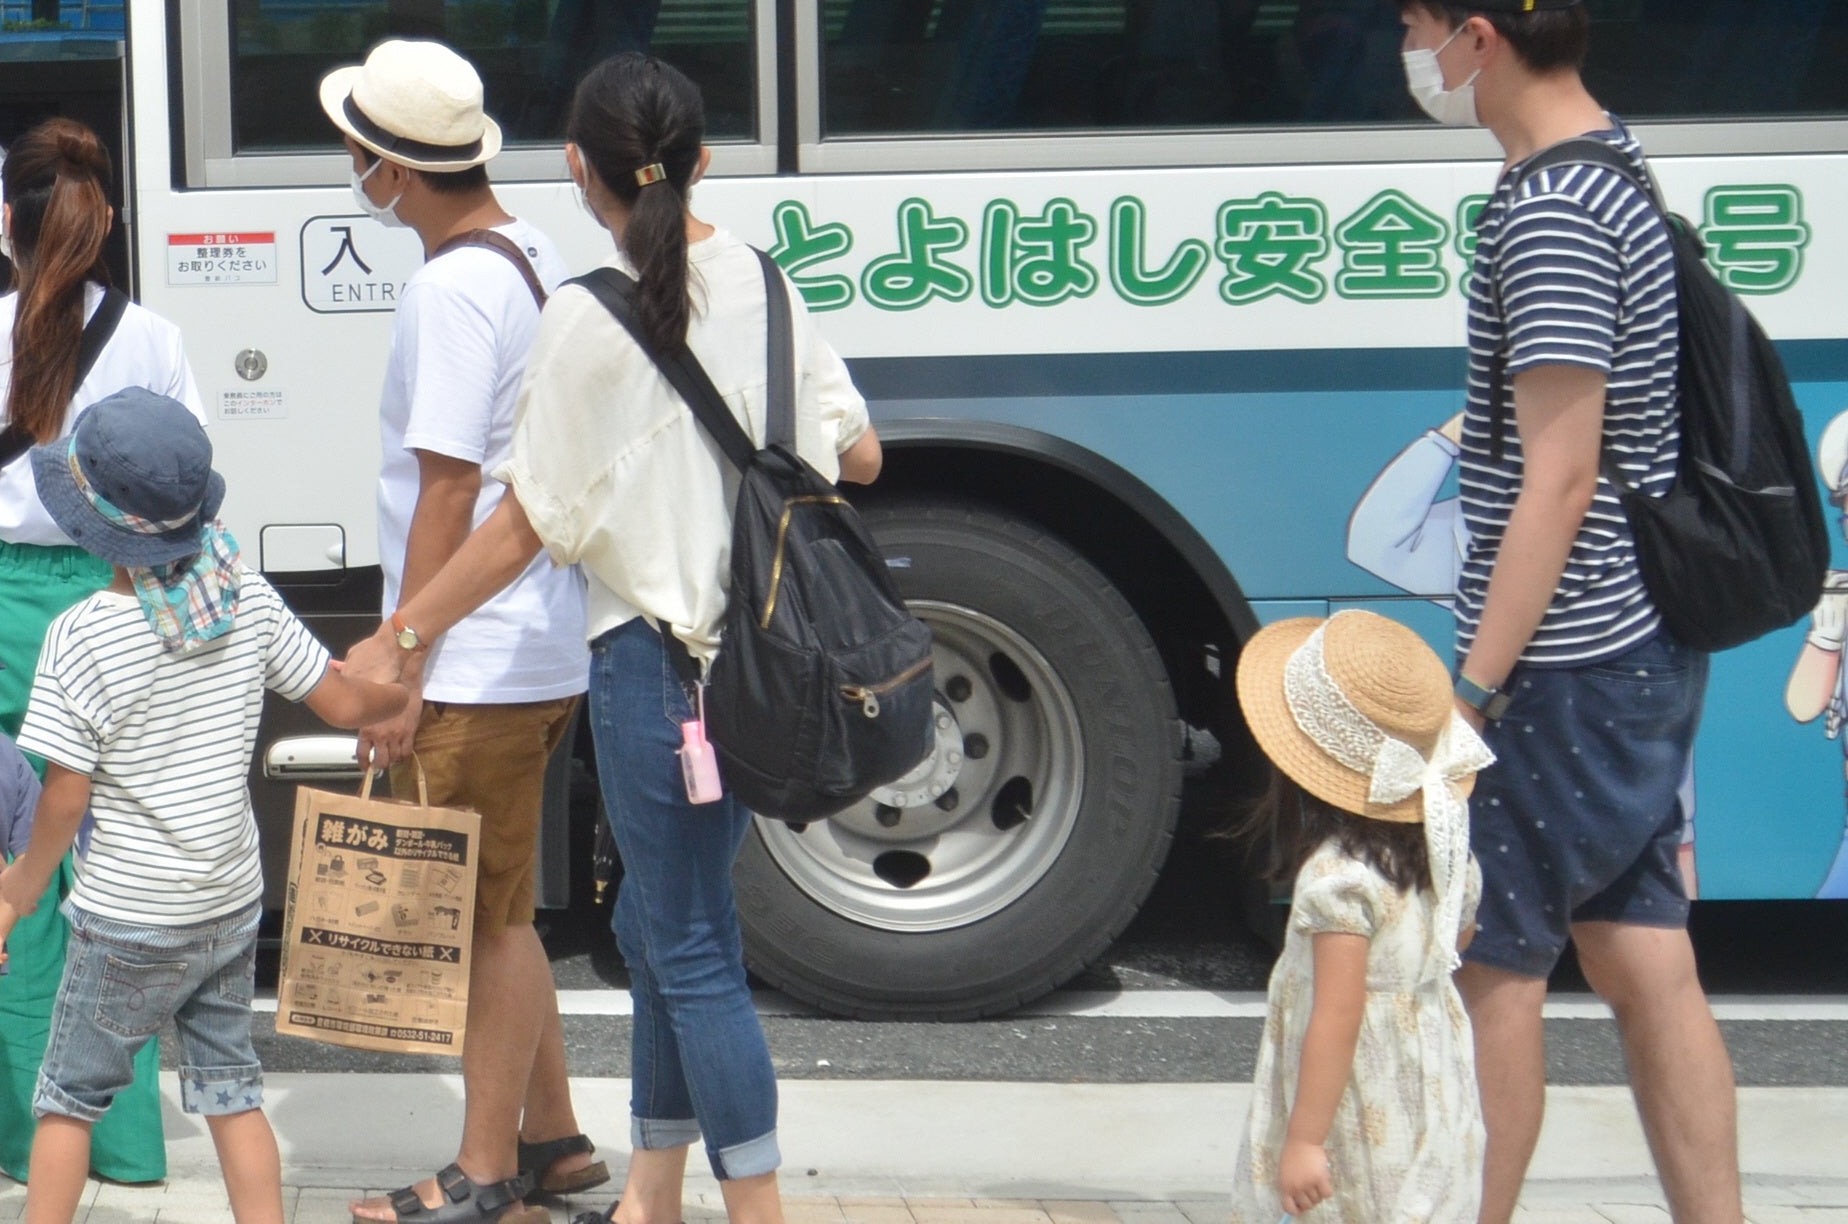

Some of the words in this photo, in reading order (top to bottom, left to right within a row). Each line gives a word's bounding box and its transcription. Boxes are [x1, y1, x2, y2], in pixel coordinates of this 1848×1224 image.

[203, 234, 239, 244] お願い
[767, 184, 1812, 312] とよはし安全号
[197, 247, 247, 258] 整理券を
[177, 260, 267, 272] お取りください
[332, 282, 406, 303] ENTR
[320, 819, 389, 852] 雑がみ
[327, 932, 435, 959] リサイクルできない紙
